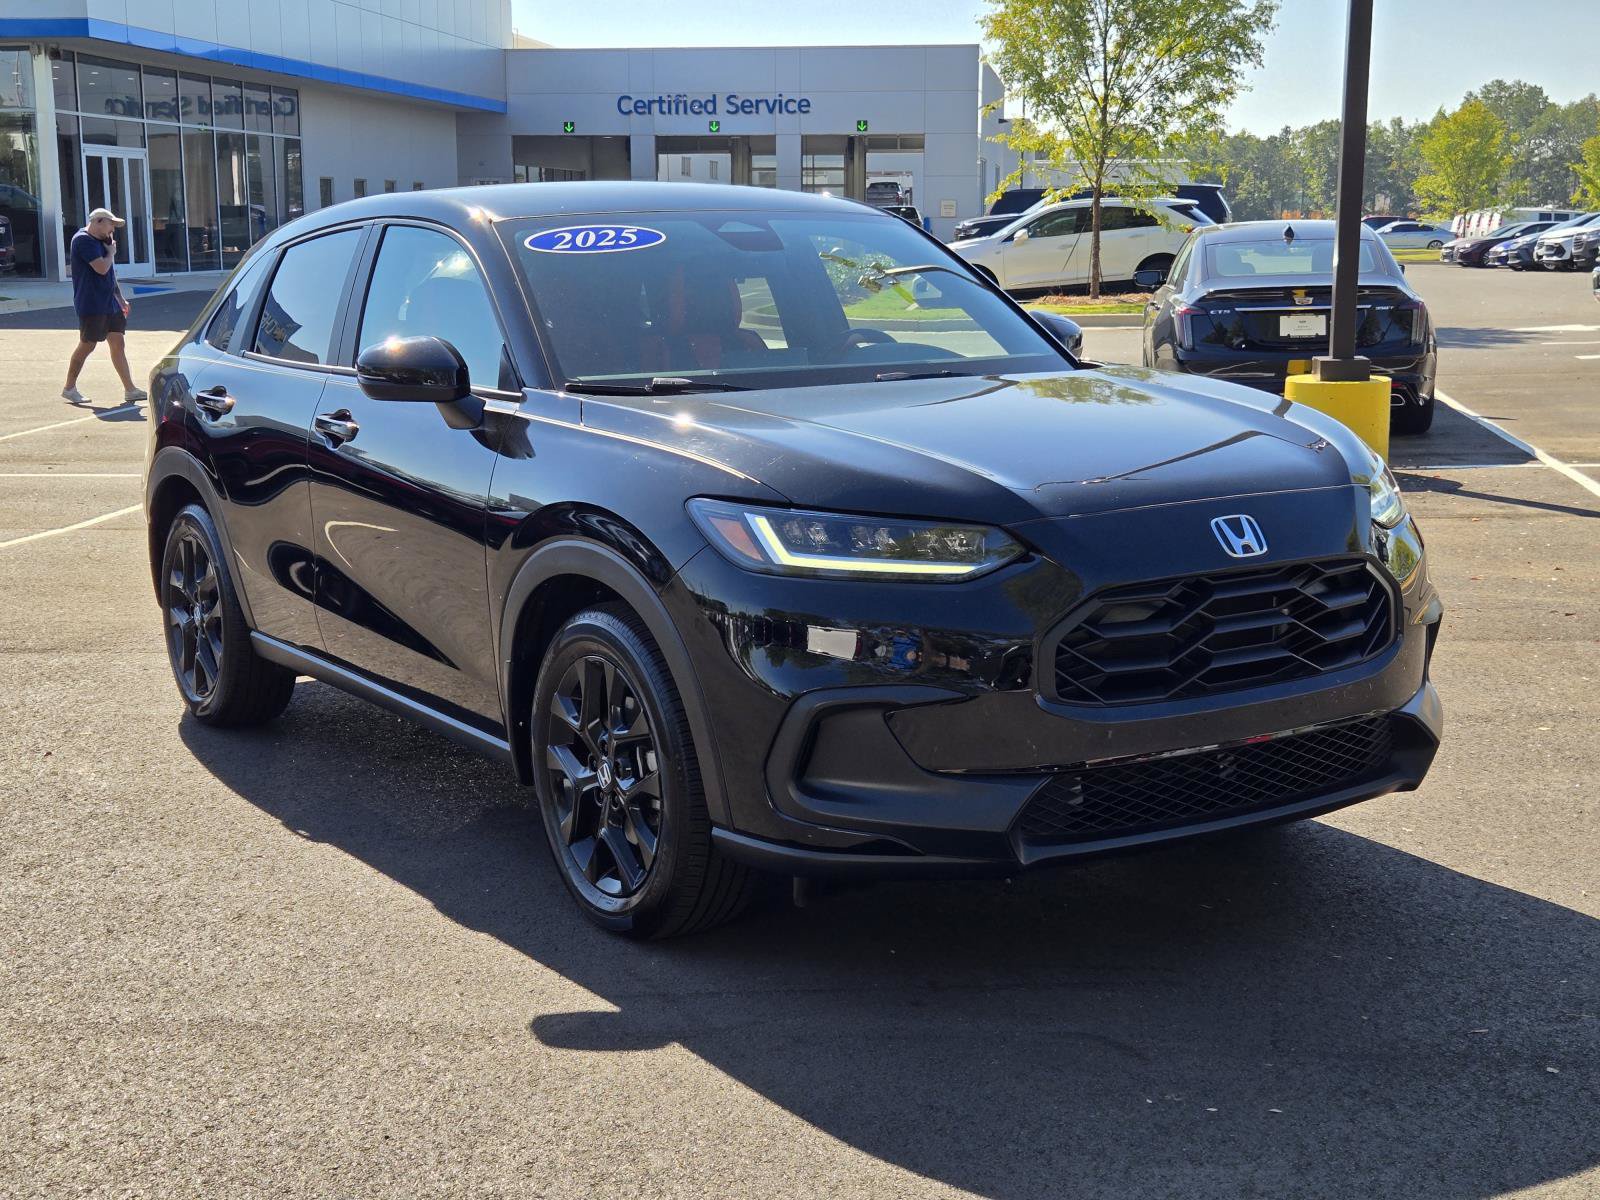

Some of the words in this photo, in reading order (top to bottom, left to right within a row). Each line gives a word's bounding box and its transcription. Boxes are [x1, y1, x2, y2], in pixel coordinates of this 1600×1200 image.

[617, 94, 717, 115] Certified
[726, 94, 811, 115] Service
[552, 228, 638, 250] 2025
